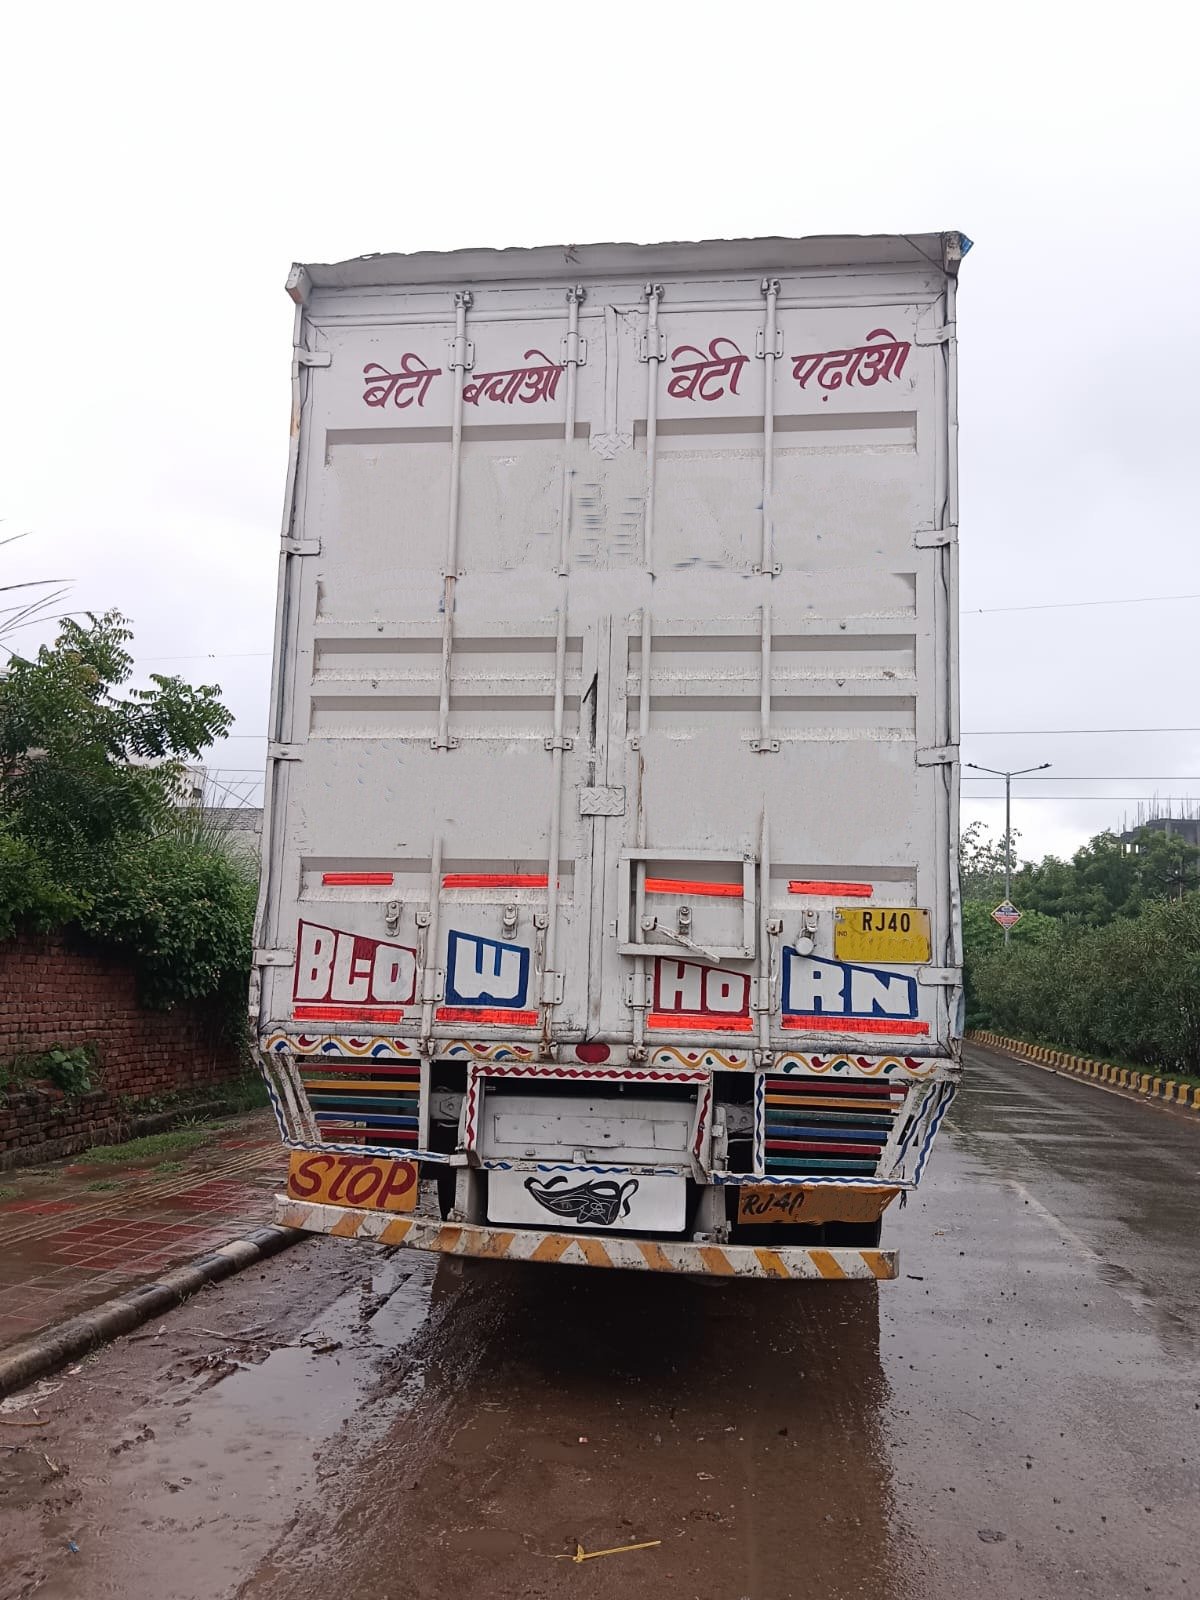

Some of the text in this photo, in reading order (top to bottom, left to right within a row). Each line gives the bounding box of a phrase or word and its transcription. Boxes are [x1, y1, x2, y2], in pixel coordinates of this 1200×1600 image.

[363, 353, 442, 408] बेटी
[462, 349, 566, 407] बचाओ
[667, 337, 750, 401] बेटी
[862, 911, 911, 932] RJ40
[289, 1155, 416, 1207] STOP
